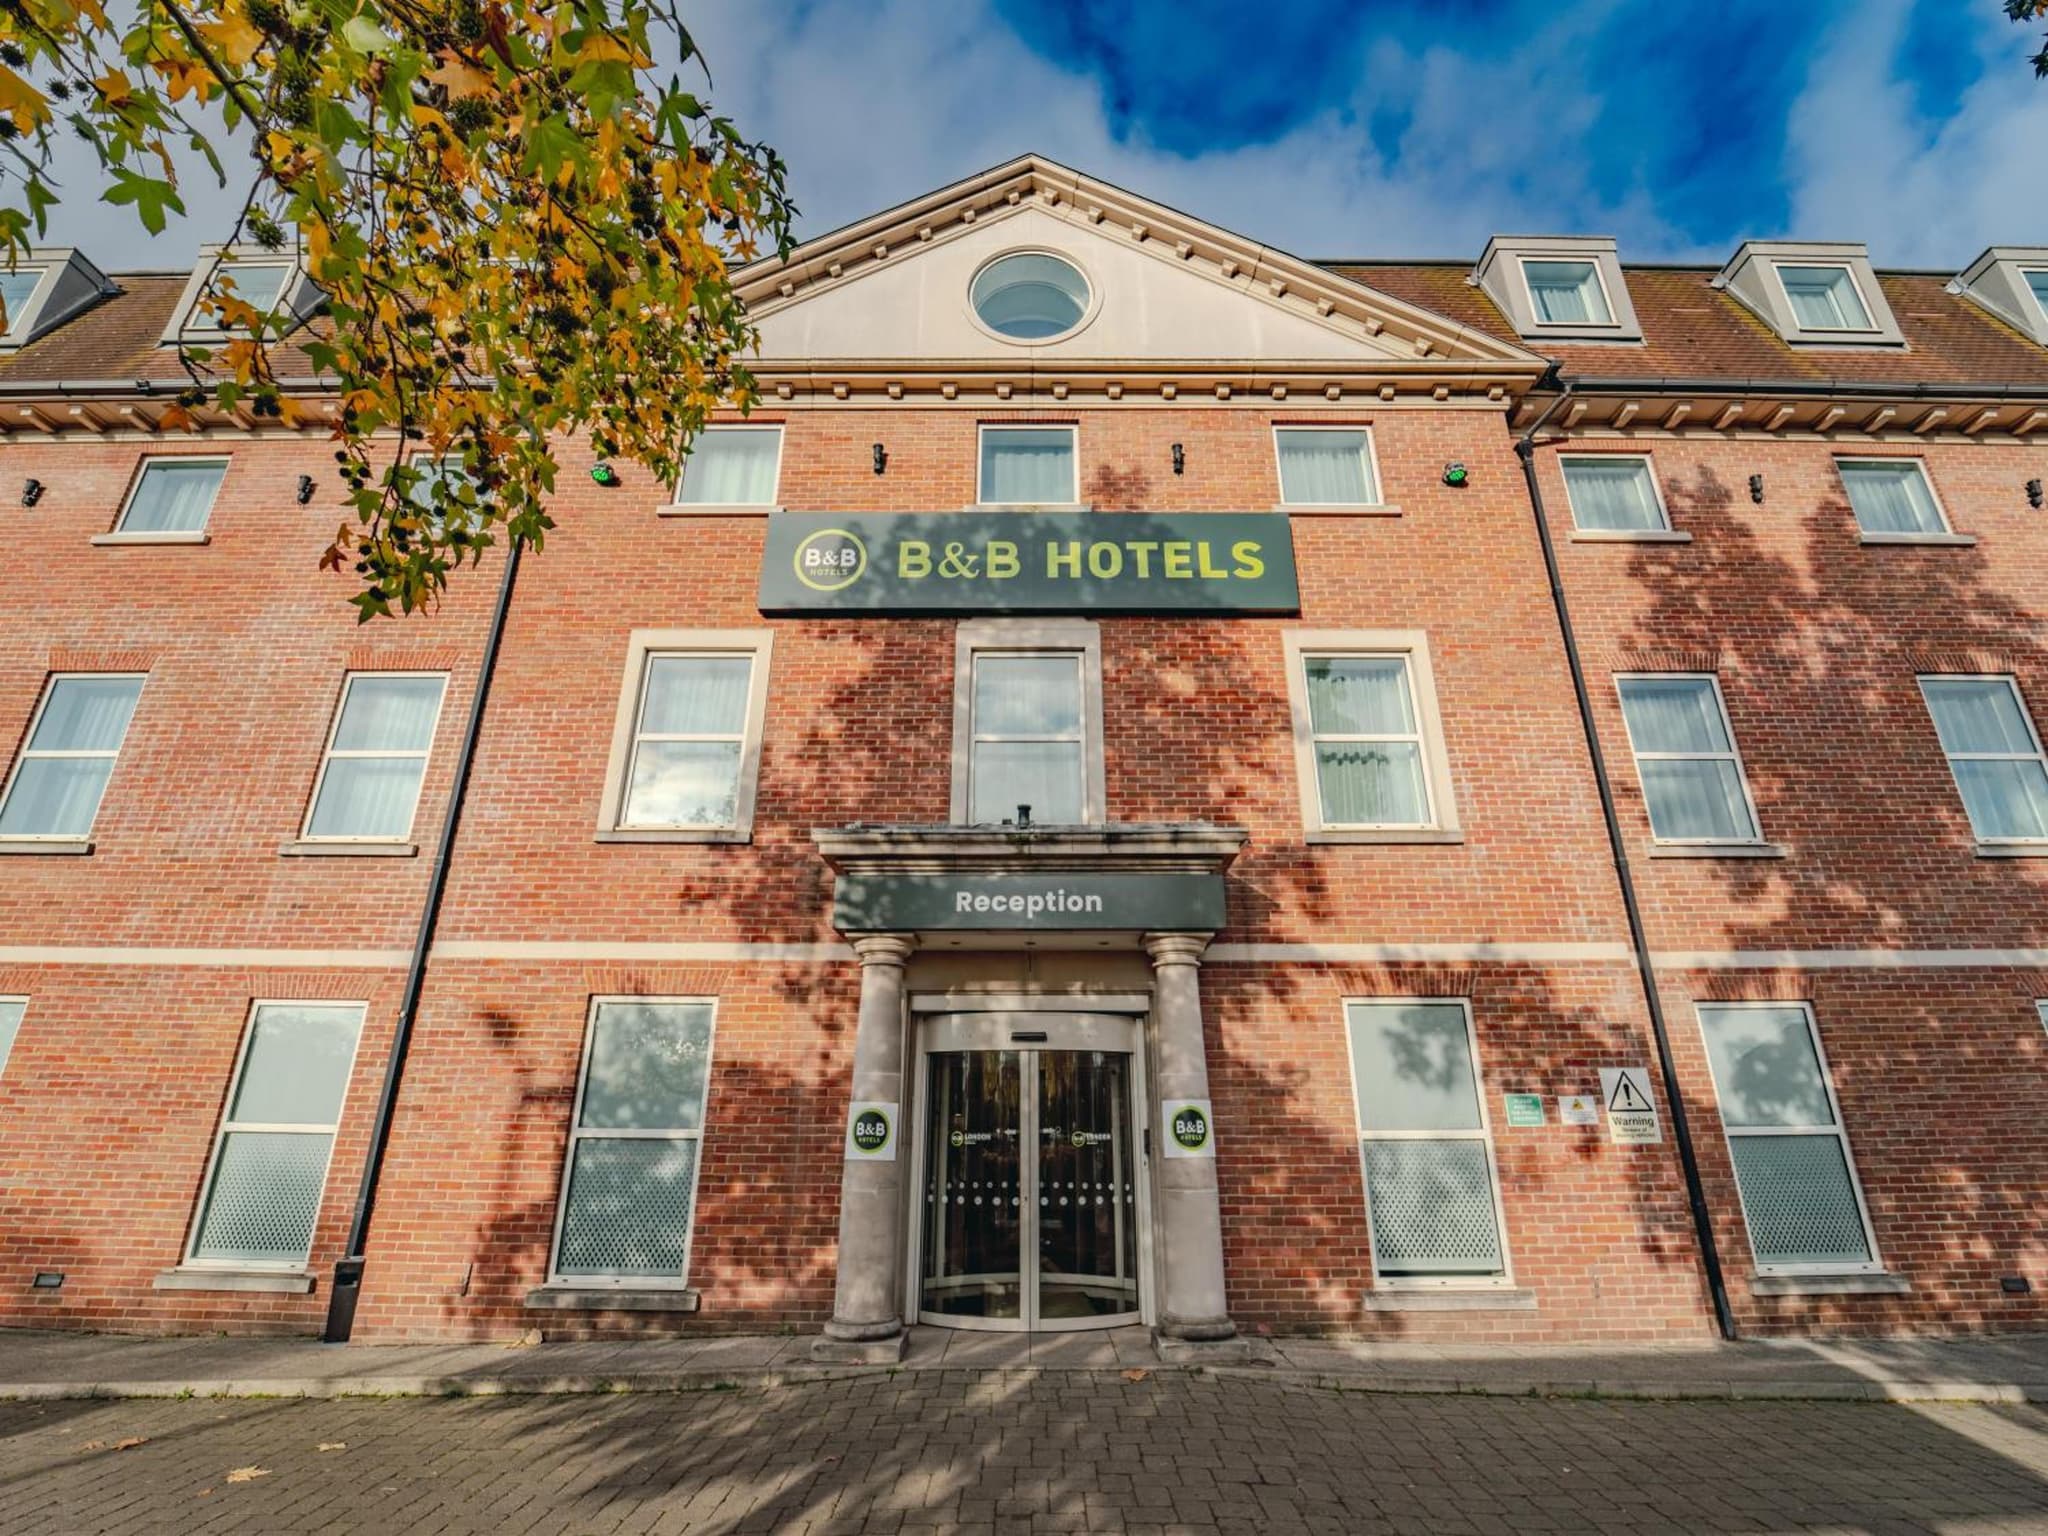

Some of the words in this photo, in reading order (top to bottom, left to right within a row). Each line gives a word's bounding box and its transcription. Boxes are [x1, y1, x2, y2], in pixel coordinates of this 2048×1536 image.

[805, 548, 857, 567] B&B
[899, 540, 1019, 579] B&B
[1047, 540, 1265, 579] HOTELS
[810, 568, 848, 576] HOTELS
[955, 889, 1103, 919] Reception
[856, 1121, 886, 1136] B&B
[1175, 1120, 1205, 1134] B&B
[1612, 1116, 1654, 1128] Warning
